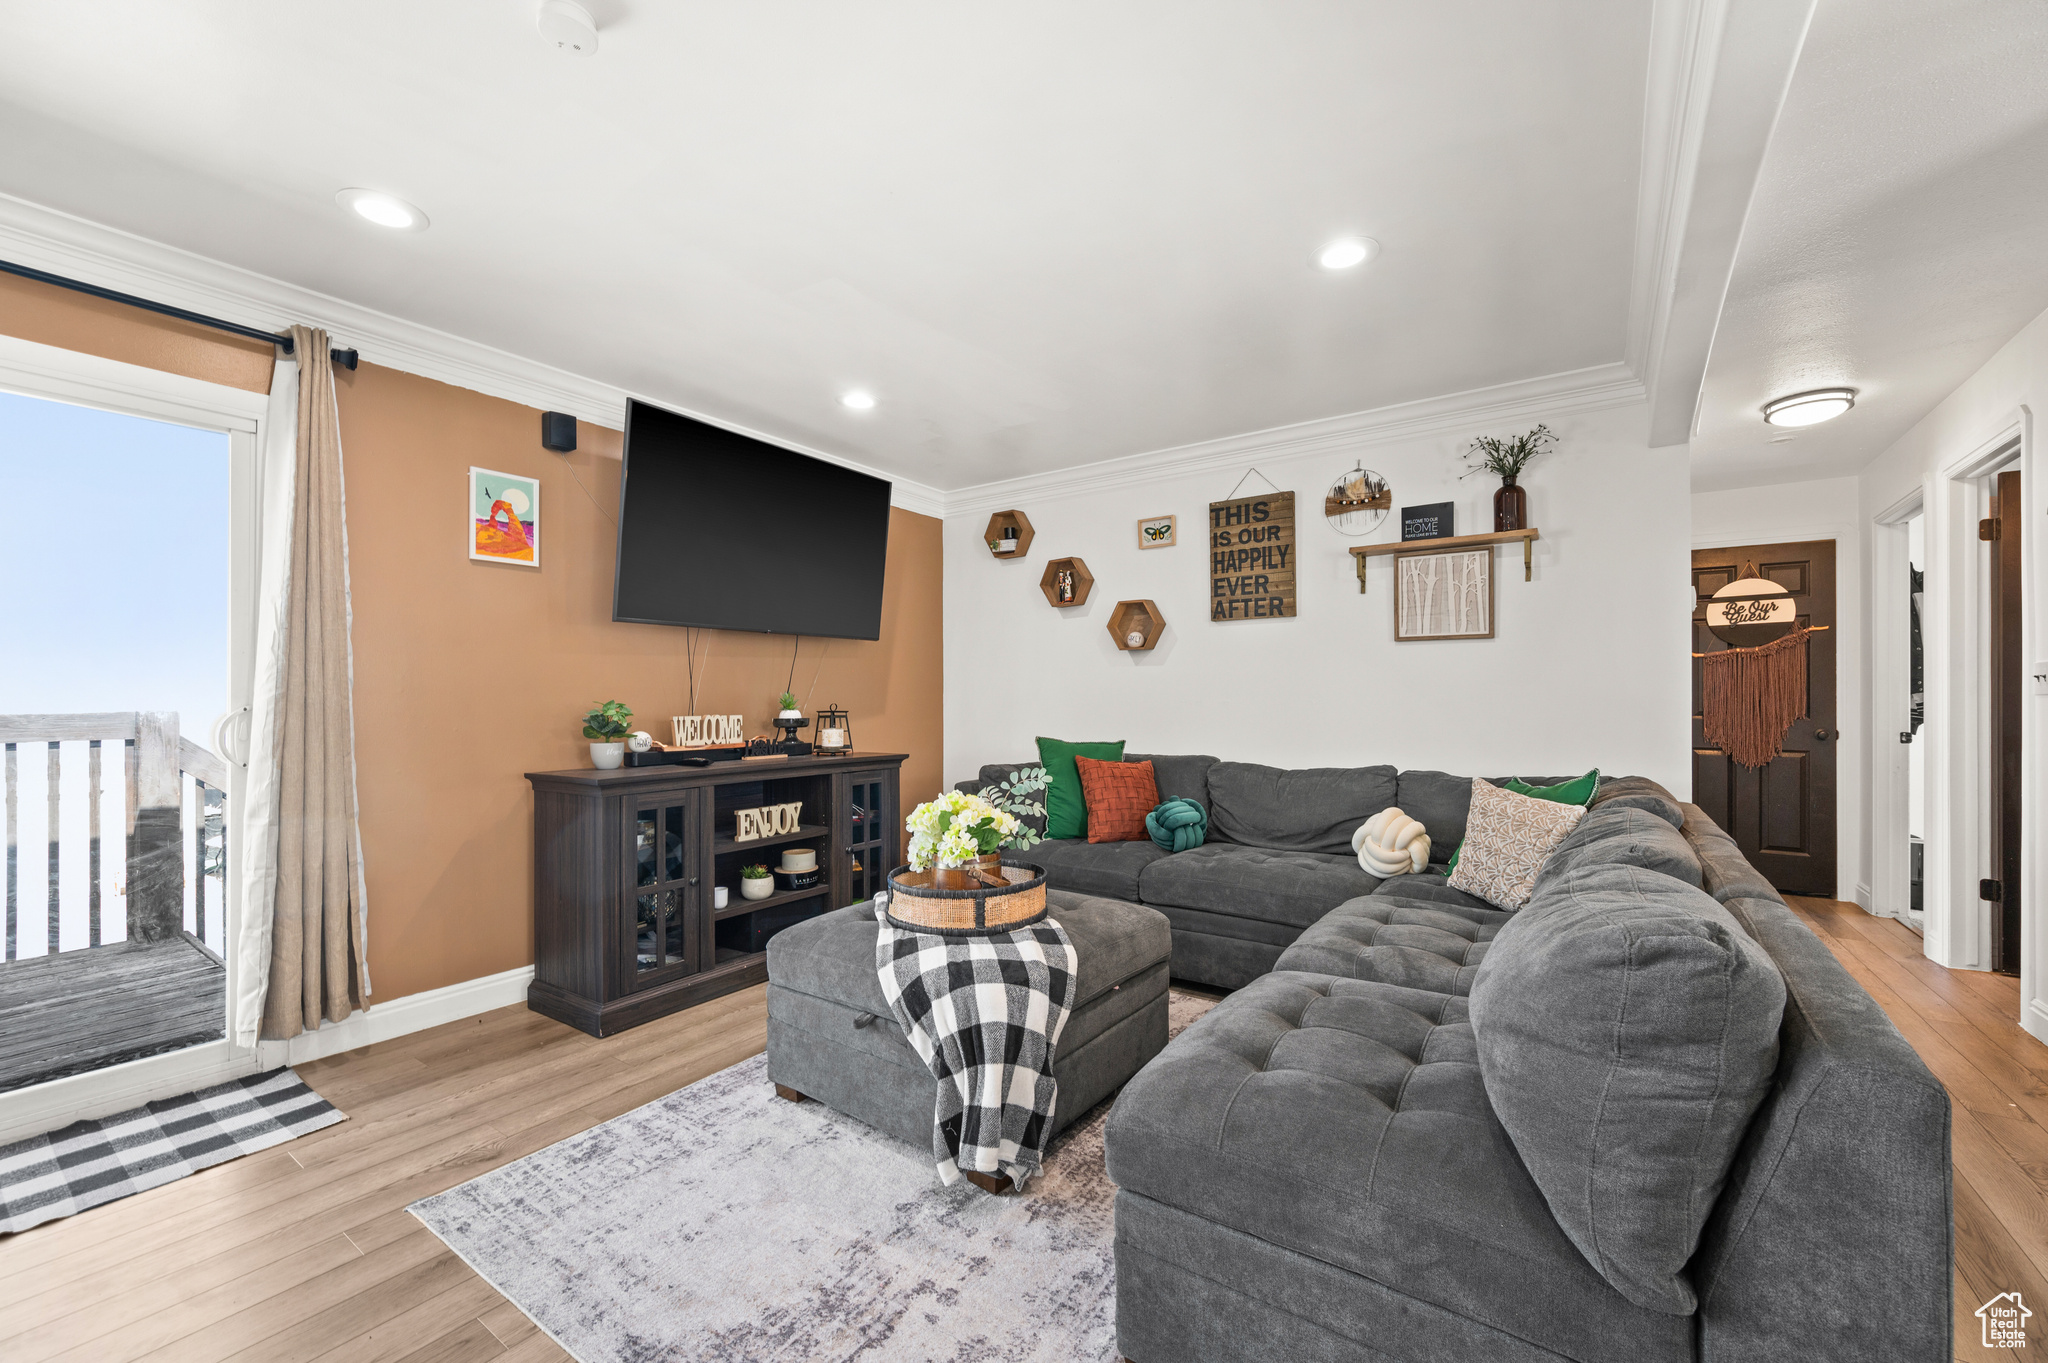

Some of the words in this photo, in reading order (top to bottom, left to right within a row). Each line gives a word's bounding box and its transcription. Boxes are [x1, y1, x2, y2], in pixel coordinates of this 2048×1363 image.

[1211, 501, 1270, 527] THIS
[1213, 531, 1232, 547] IS
[1238, 525, 1280, 544] OUR
[1405, 521, 1438, 534] HOME
[1213, 544, 1290, 574] HAPPILY
[1213, 575, 1269, 597] EVER
[1213, 596, 1284, 619] AFTER
[1722, 600, 1746, 615] Be
[1748, 600, 1779, 614] Our
[1725, 610, 1770, 628] Guest
[672, 714, 743, 746] WELCOME
[734, 801, 803, 842] ENJOY
